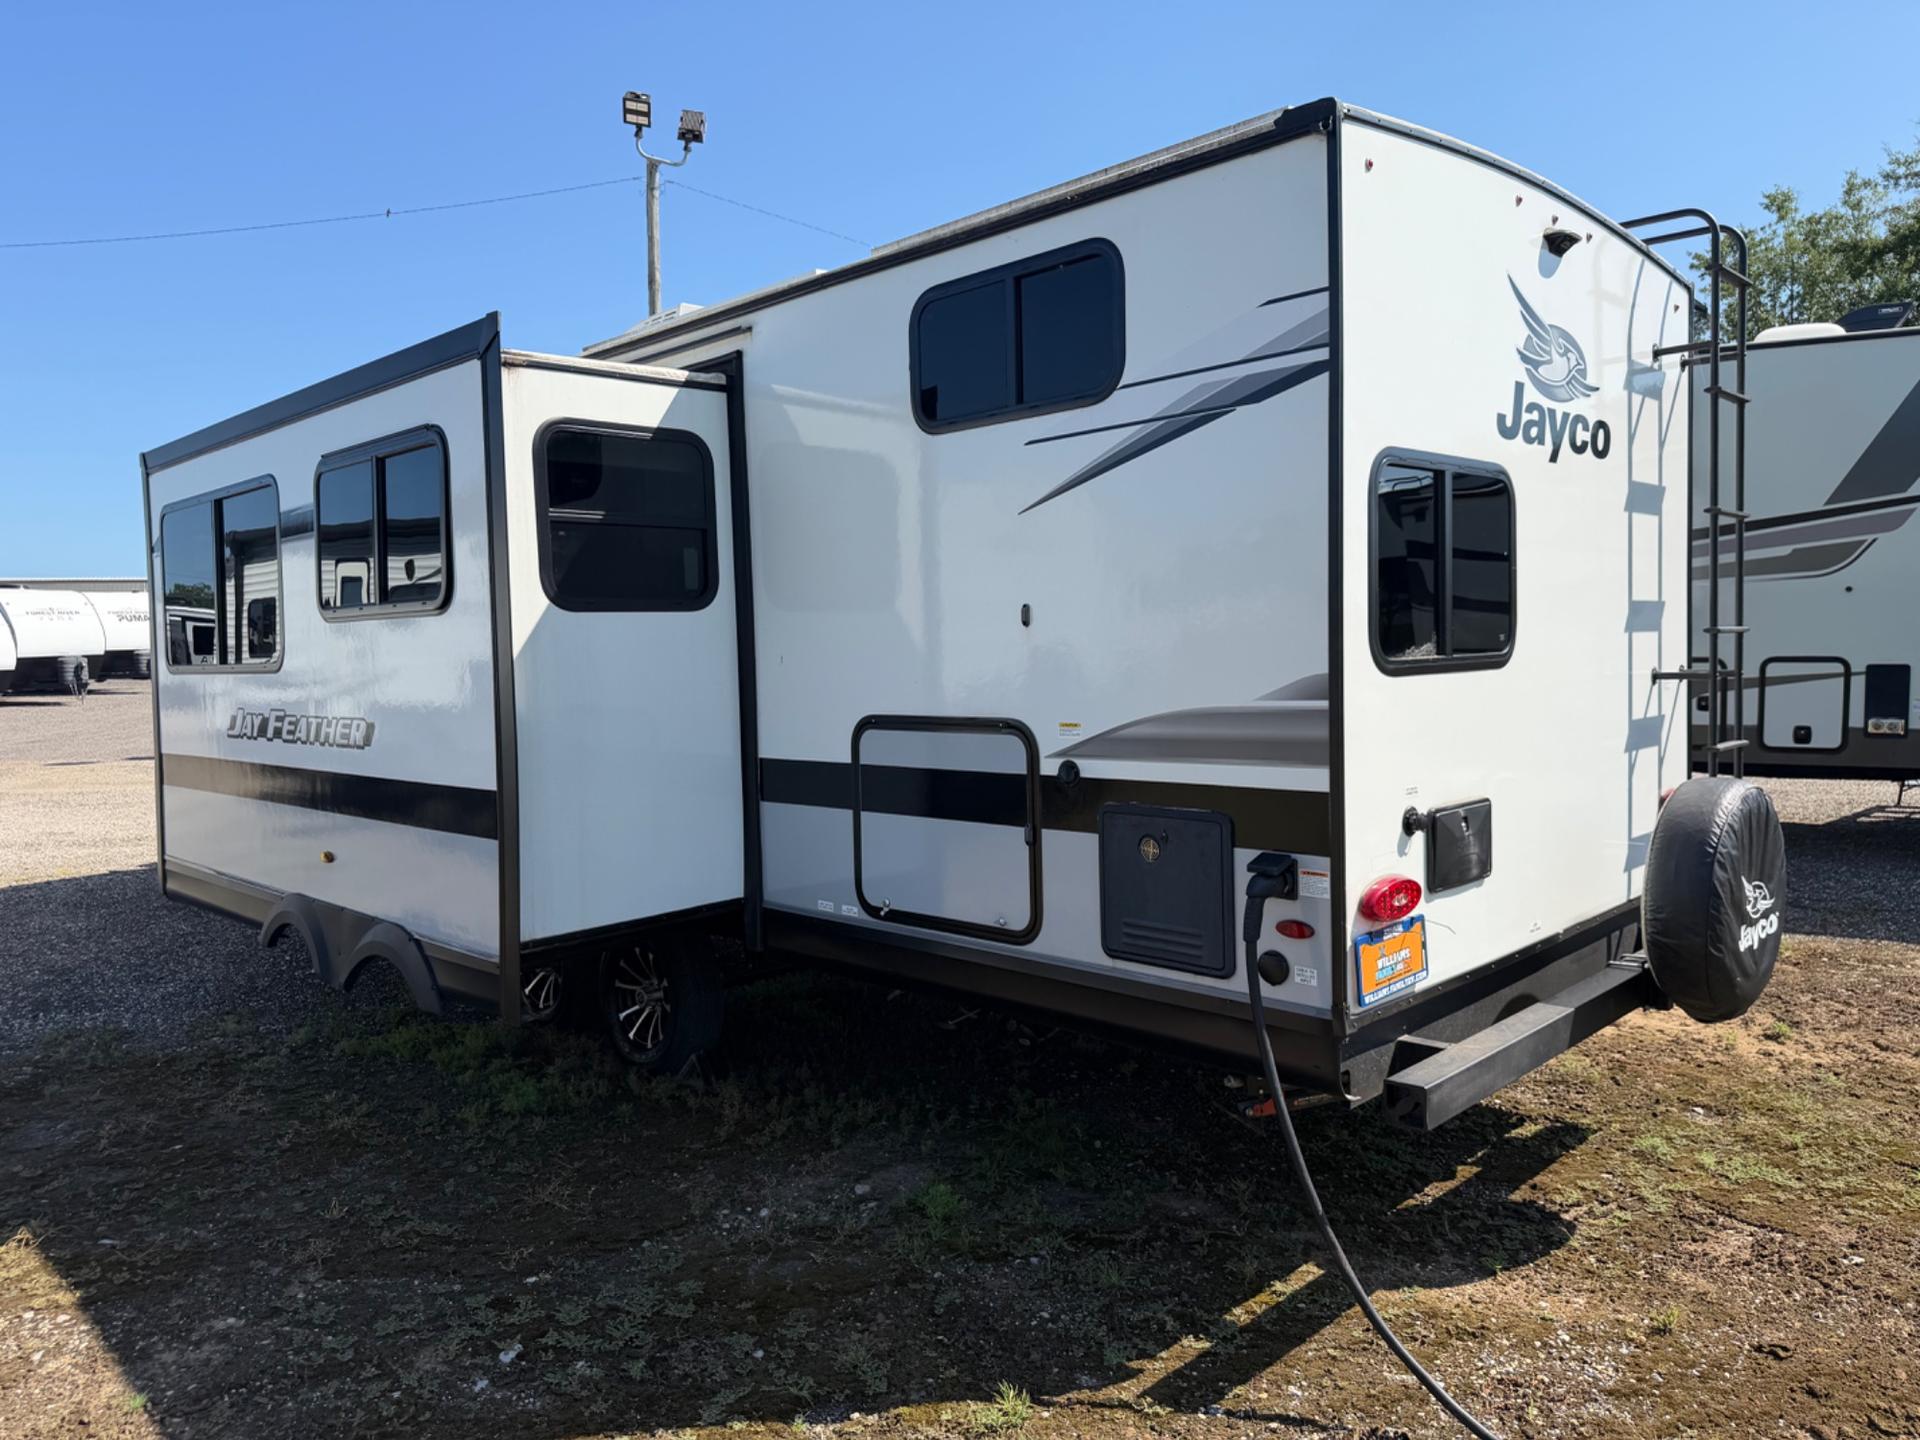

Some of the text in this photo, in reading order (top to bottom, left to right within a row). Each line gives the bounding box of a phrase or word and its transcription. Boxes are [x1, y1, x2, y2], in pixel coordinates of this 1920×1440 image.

[1496, 380, 1611, 464] Jayco
[227, 707, 370, 749] JAY FEATHER
[1738, 913, 1779, 952] Jayco
